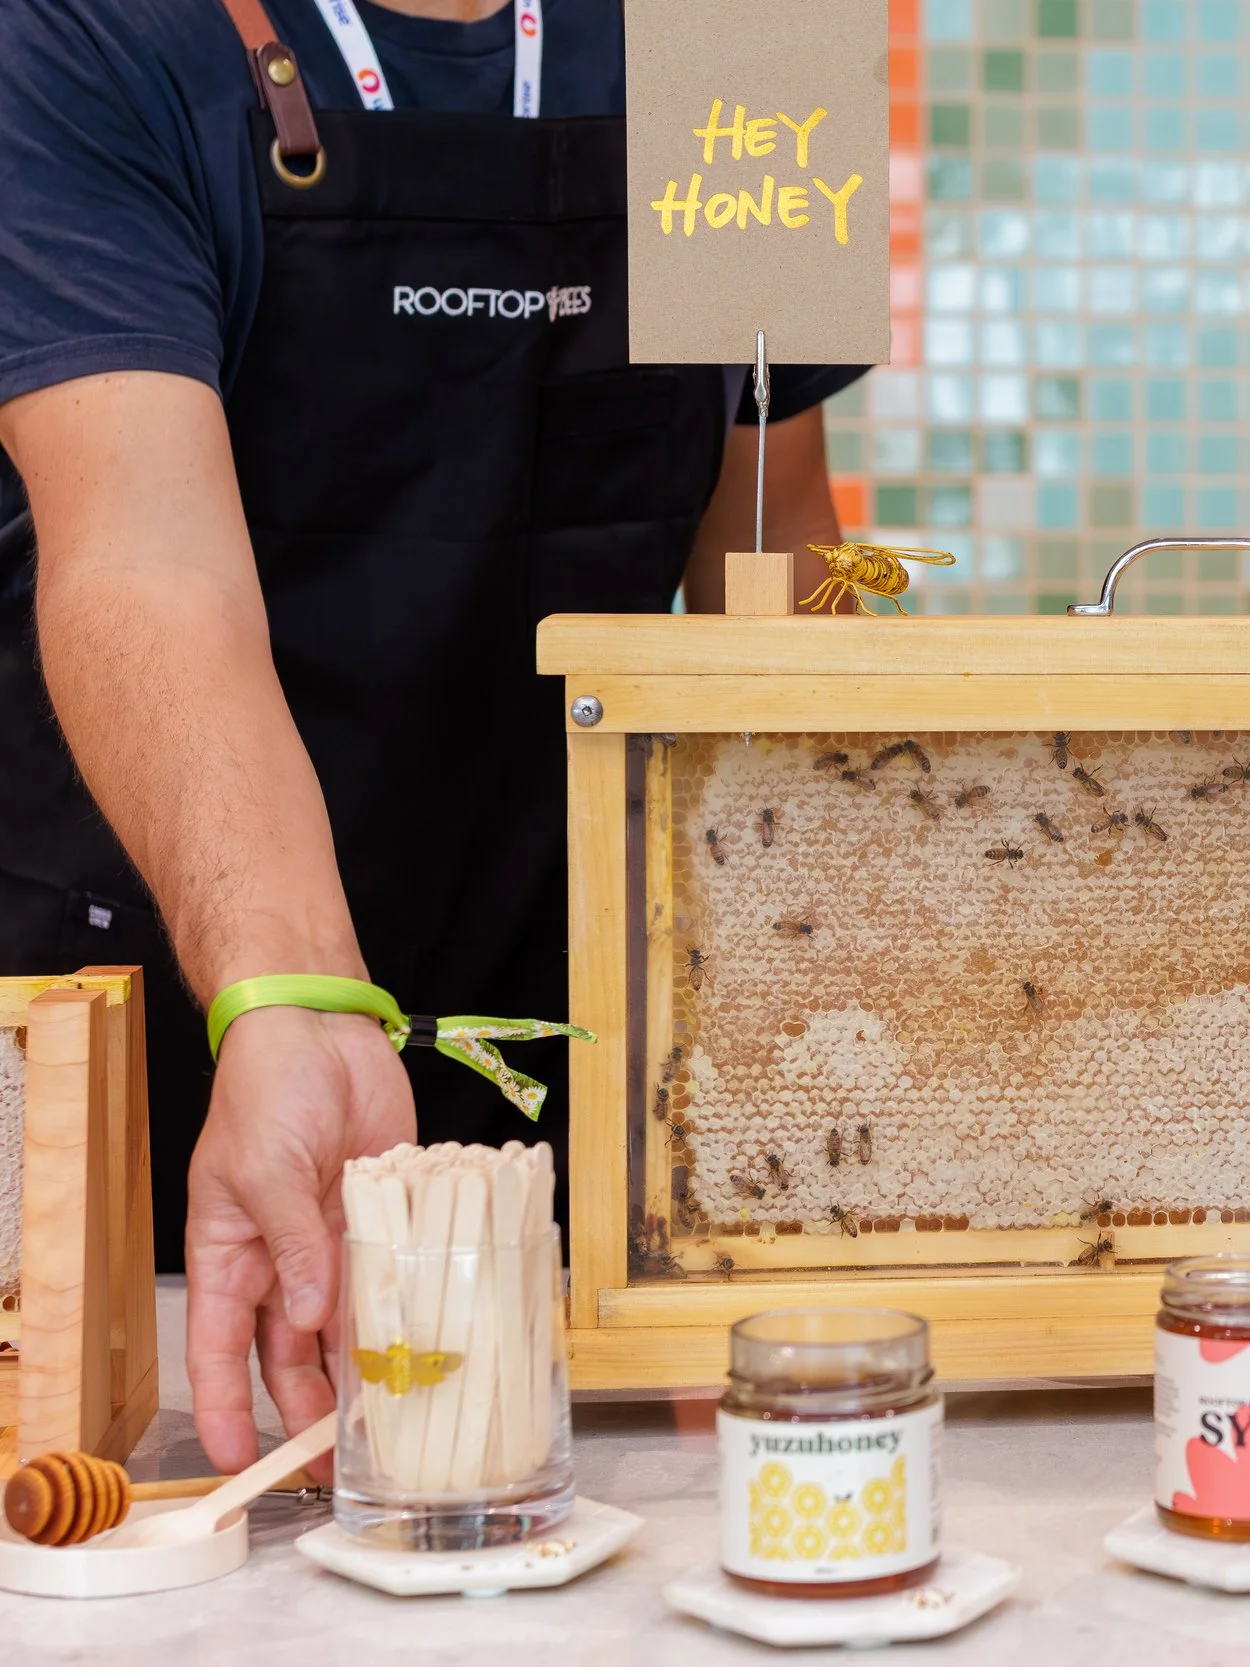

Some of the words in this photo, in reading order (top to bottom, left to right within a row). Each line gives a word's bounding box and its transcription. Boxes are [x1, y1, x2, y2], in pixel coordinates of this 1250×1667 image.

[692, 98, 828, 168] HEY
[651, 173, 864, 245] HONEY
[393, 286, 545, 319] ROOFTOP
[749, 1427, 903, 1457] yuzuhoney
